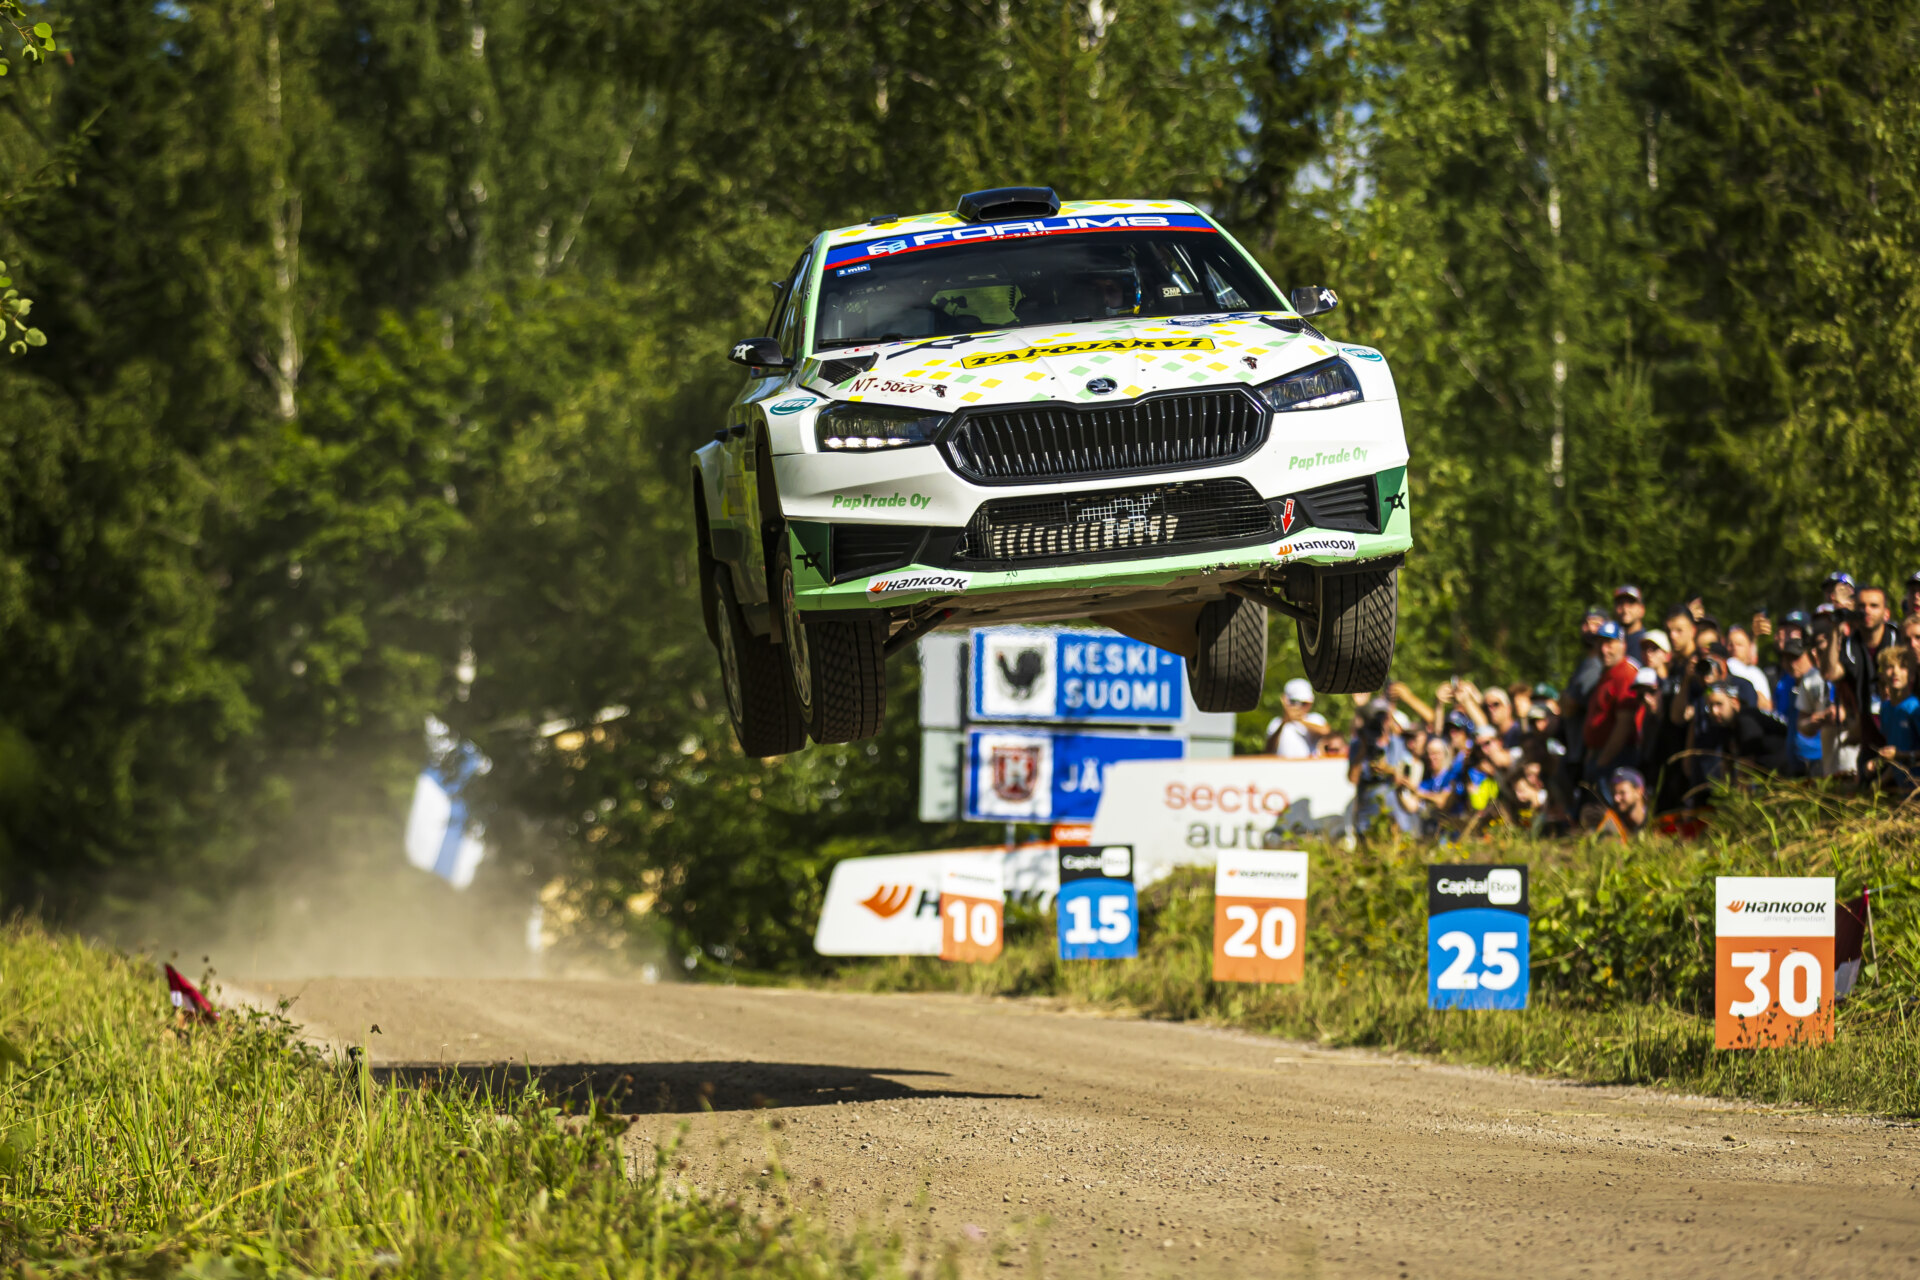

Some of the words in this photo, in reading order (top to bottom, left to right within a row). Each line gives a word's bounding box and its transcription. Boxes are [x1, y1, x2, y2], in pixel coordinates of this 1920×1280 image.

[913, 216, 1170, 246] FORUM8
[1289, 448, 1350, 470] PapTrade
[1353, 447, 1368, 462] Oy
[832, 493, 906, 510] PapTrade
[909, 493, 931, 510] Oy
[1063, 642, 1173, 675] KESKI-
[1063, 678, 1170, 711] SUOMI
[1060, 757, 1101, 793] JÄ
[1164, 782, 1290, 816] secto
[946, 900, 998, 947] 10
[1065, 895, 1131, 944] 15
[1223, 905, 1297, 960] 20
[1437, 931, 1520, 990] 25
[1728, 951, 1822, 1017] 30
